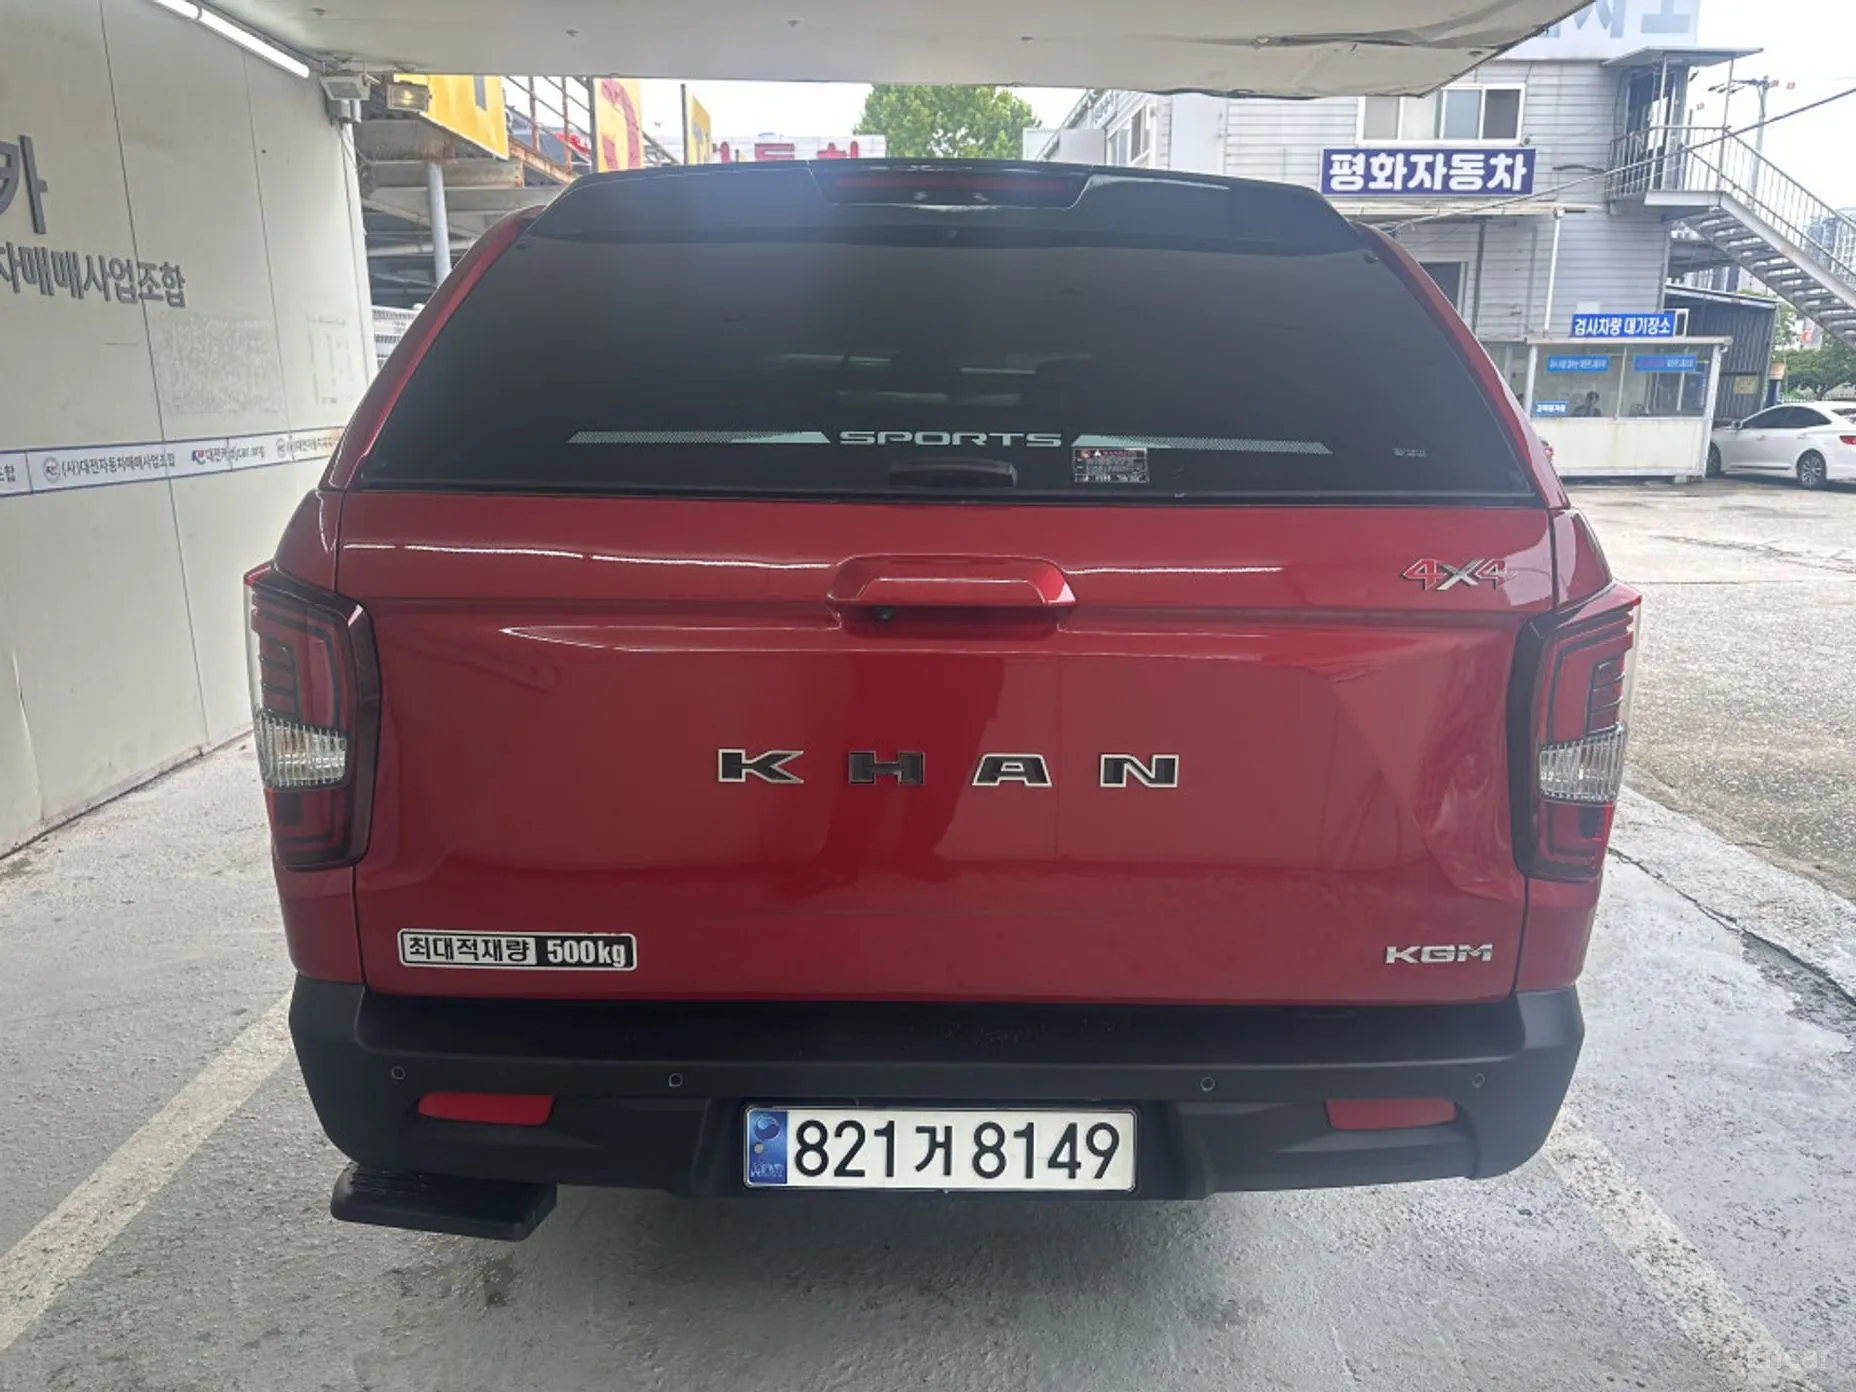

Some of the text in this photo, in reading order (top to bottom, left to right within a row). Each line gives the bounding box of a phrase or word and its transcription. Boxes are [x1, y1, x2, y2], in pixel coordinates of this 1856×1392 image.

[1329, 152, 1528, 191] 평화자동차
[1574, 317, 1672, 336] 검사차량 대기장소
[839, 430, 1063, 448] SPORTS
[717, 747, 1180, 788] KHAN
[408, 936, 626, 968] 최대적재량 500kg
[1385, 943, 1494, 964] KGM
